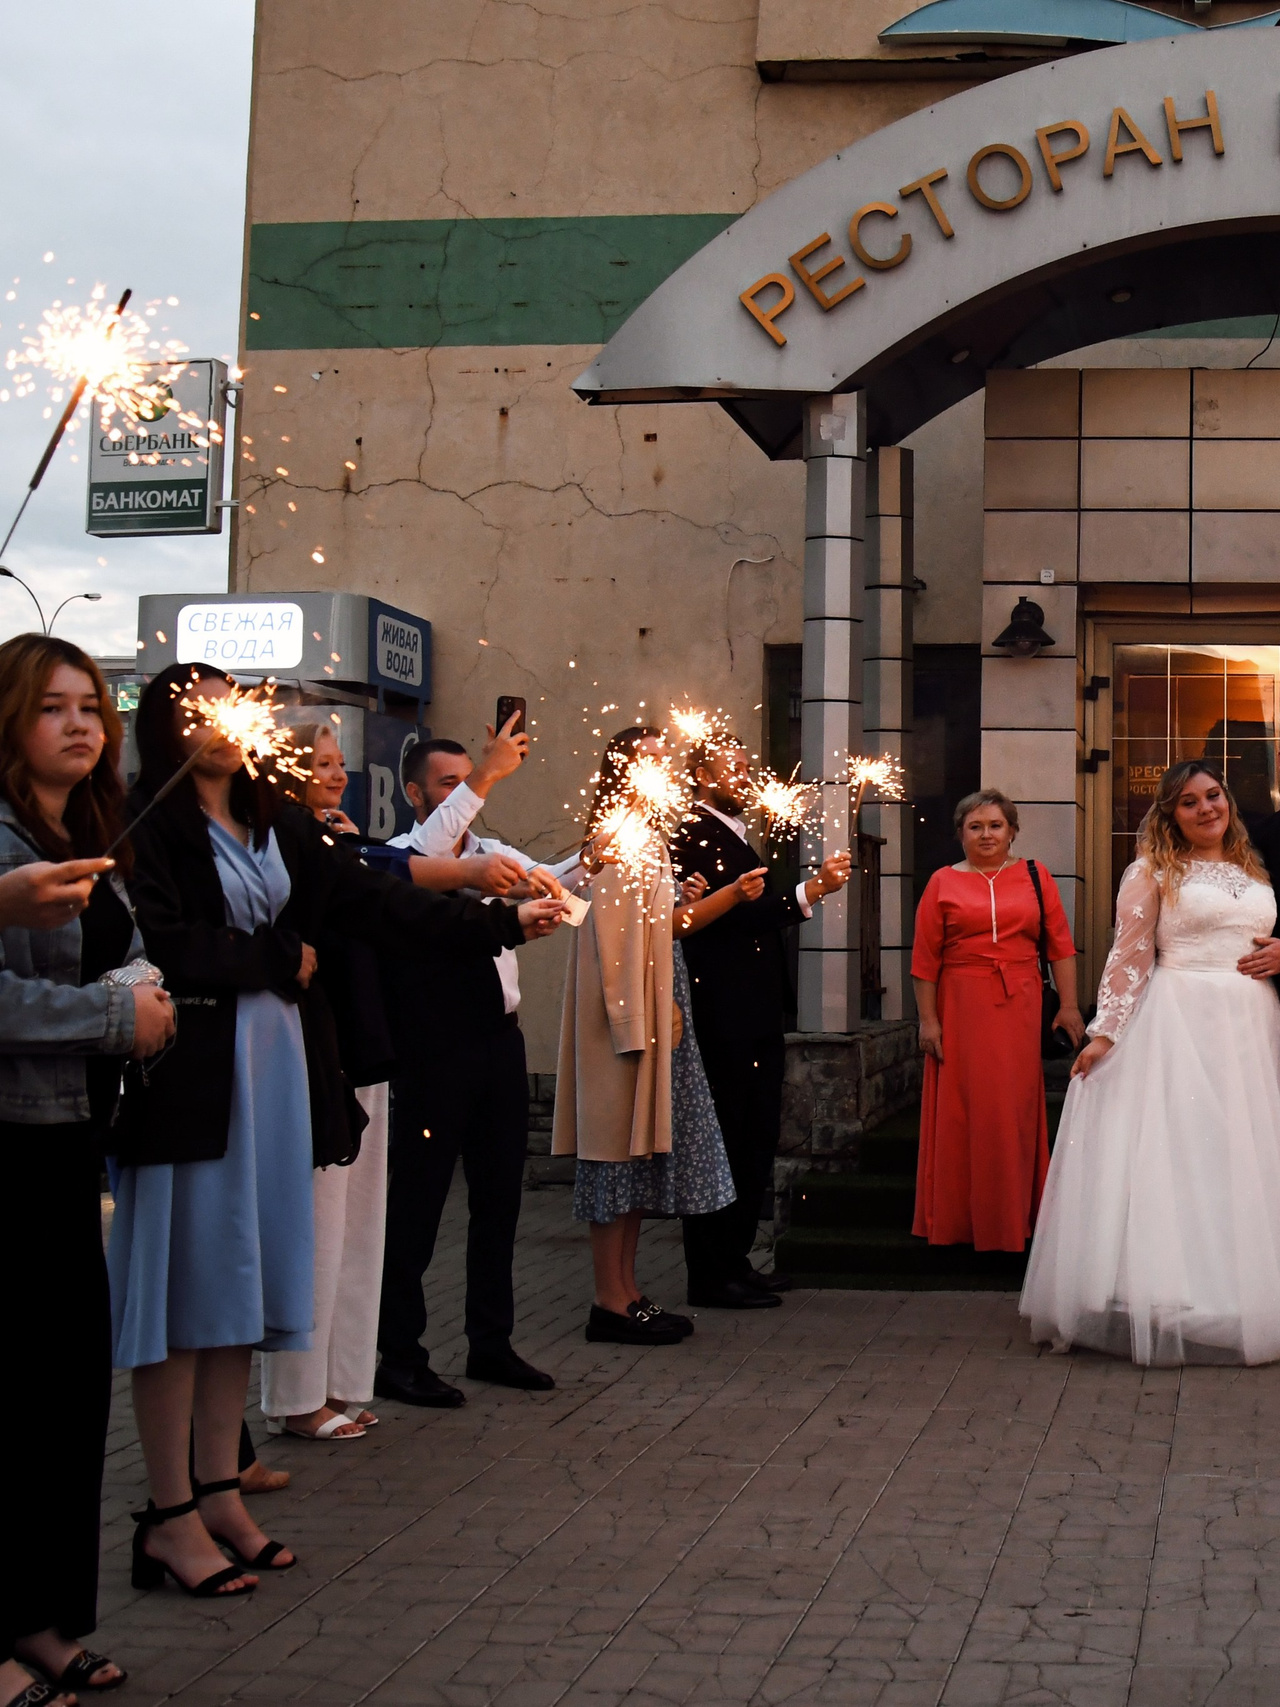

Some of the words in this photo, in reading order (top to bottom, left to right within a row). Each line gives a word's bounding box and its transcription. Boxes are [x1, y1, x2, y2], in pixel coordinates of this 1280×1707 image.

[739, 90, 1225, 346] РЕСТОРАН
[100, 432, 201, 452] СБЕРБАНК
[92, 489, 203, 511] БАНКОМАТ
[188, 611, 293, 632] СВЕЖАЯ
[381, 620, 419, 654] ЖИВАЯ
[203, 639, 275, 662] ВОДА
[386, 653, 415, 680] ВОДА
